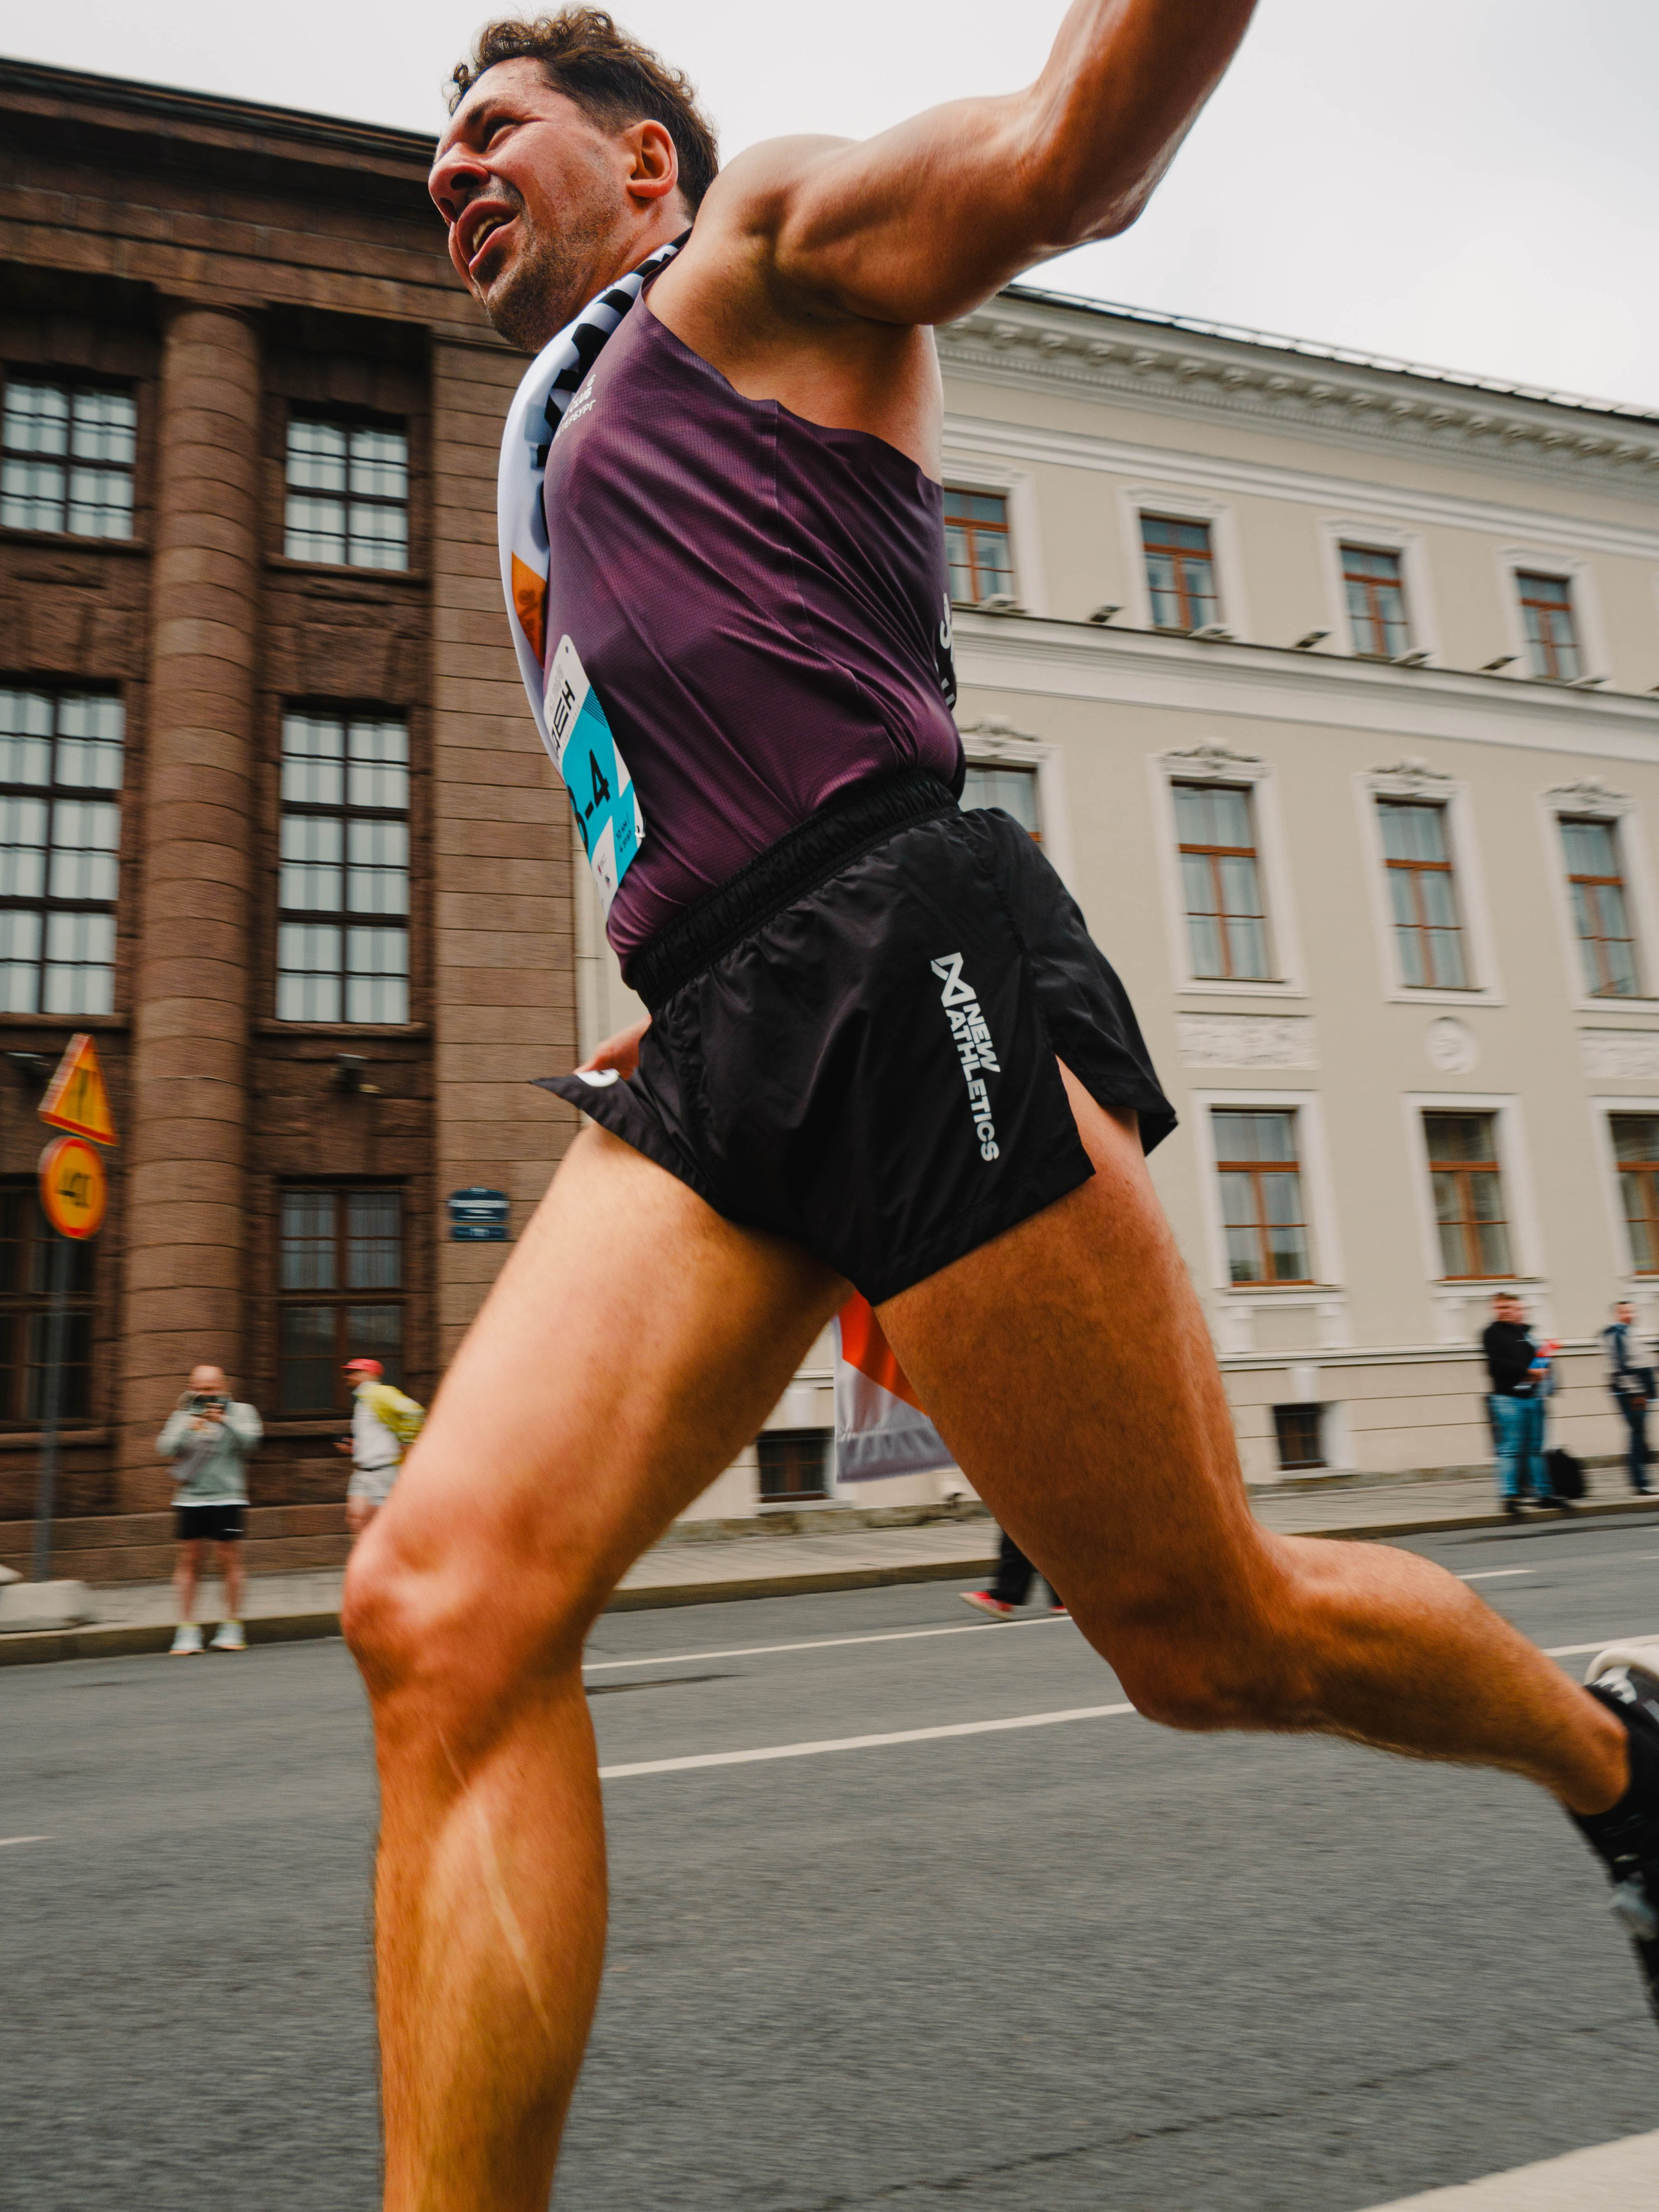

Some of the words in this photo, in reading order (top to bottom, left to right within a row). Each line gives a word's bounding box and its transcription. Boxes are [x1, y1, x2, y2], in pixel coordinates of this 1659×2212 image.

[569, 386, 592, 413] CLUB
[962, 1003, 1001, 1073] NEW
[945, 1008, 1000, 1162] ATHLETICS
